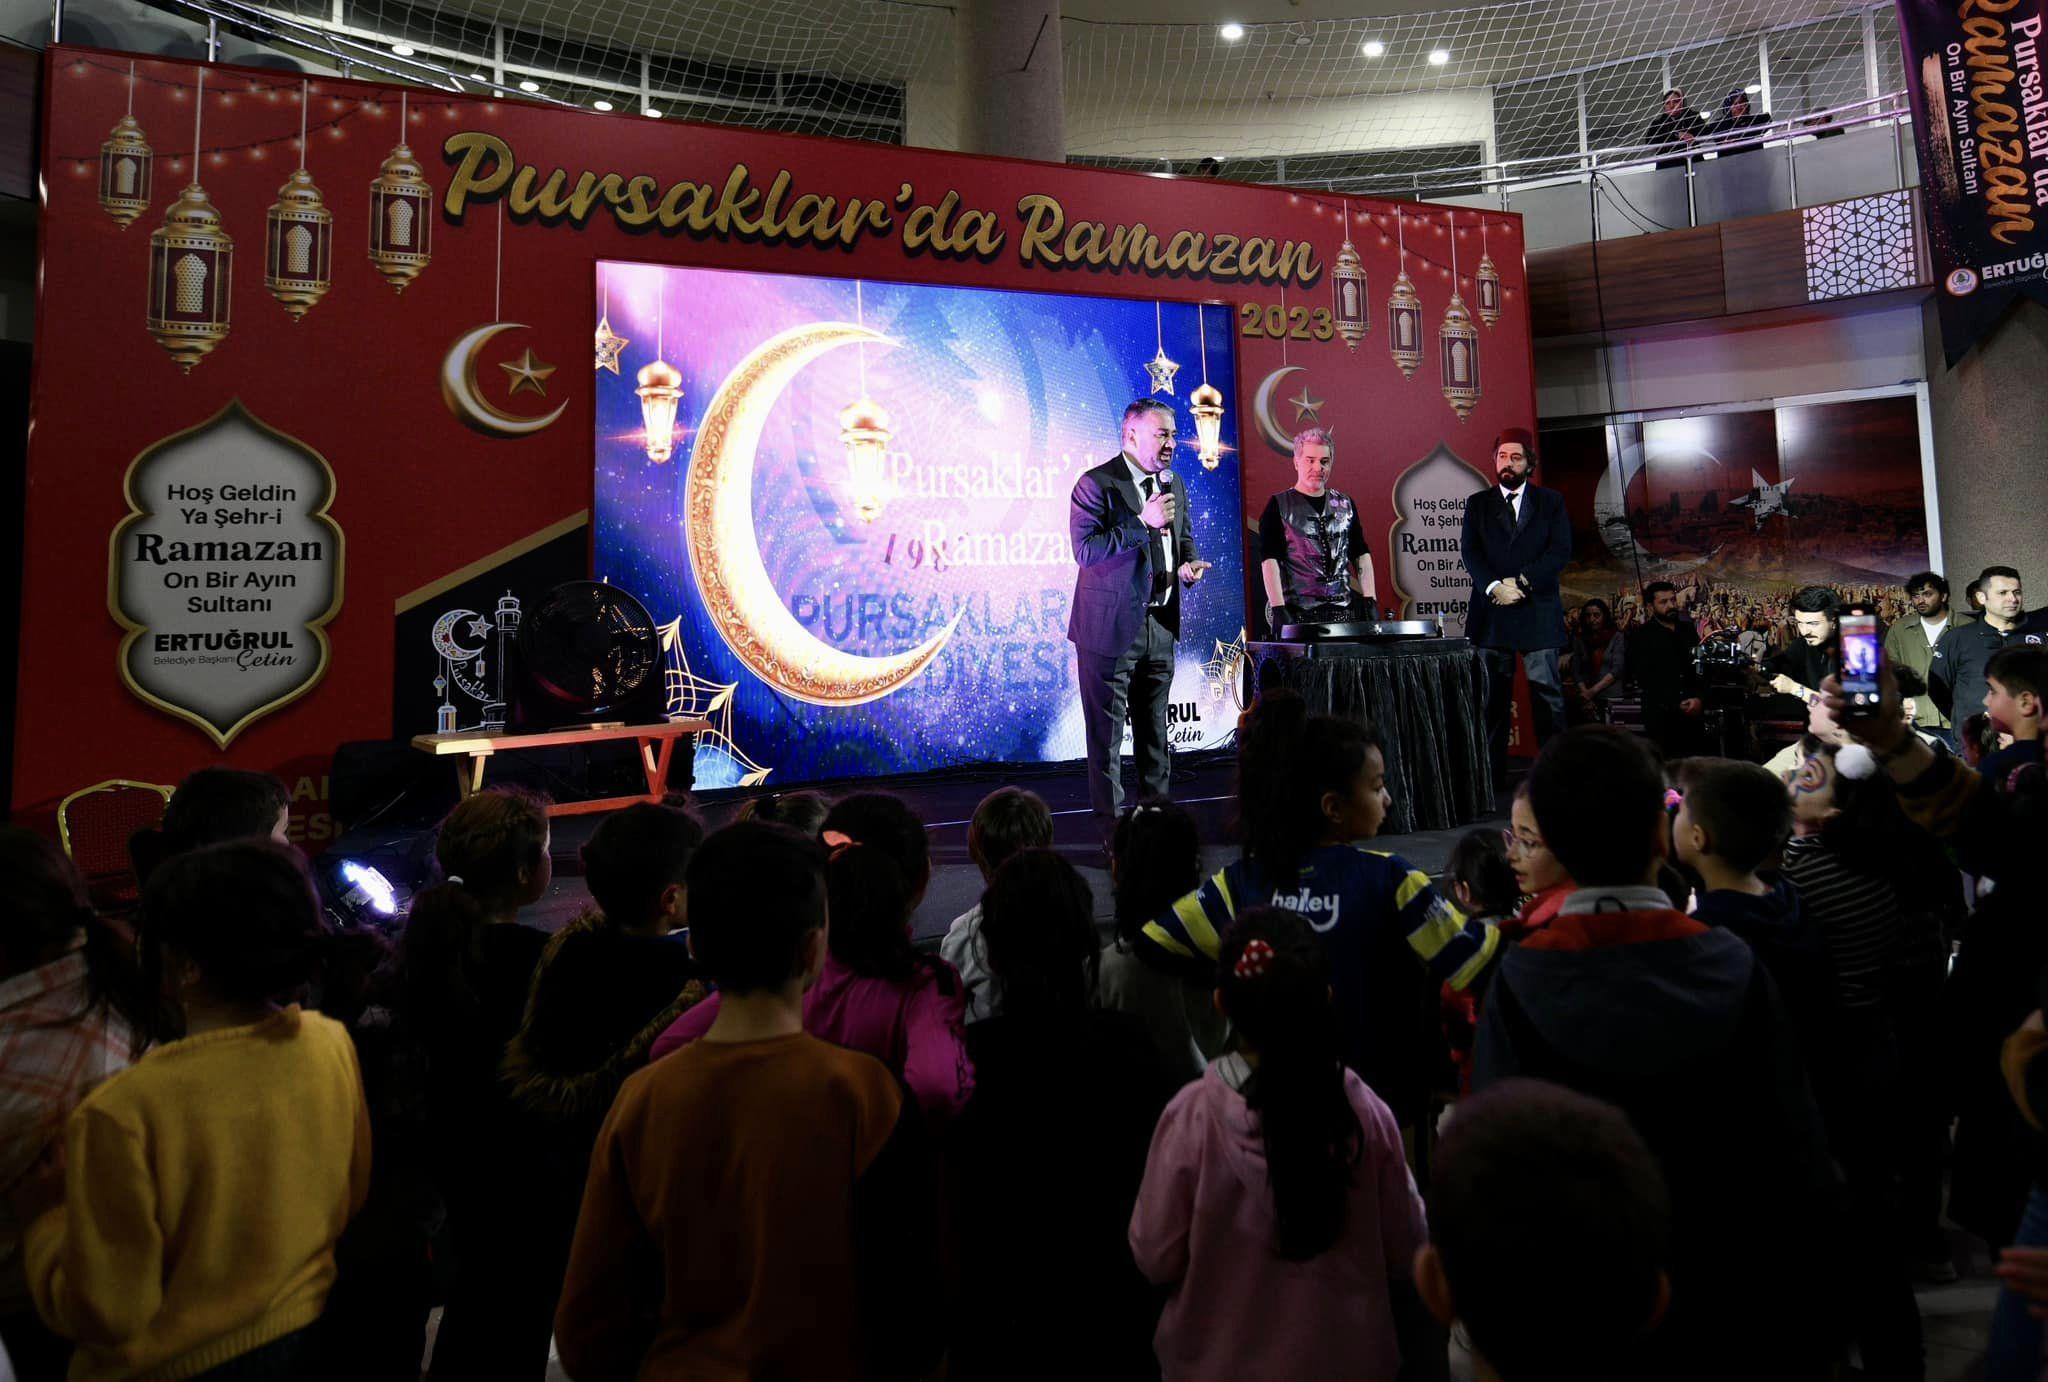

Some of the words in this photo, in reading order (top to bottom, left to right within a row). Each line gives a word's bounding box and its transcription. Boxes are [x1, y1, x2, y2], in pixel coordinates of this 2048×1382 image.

[1946, 42, 1961, 66] On
[1950, 70, 1967, 93] Bir
[1953, 99, 1969, 134] Ayın
[1960, 138, 1979, 195] Sultanı
[442, 130, 1005, 255] Pursaklar'da
[1018, 194, 1322, 283] Ramazan
[1982, 252, 2048, 281] ERTUĞ
[1240, 302, 1334, 340] 2023
[167, 484, 214, 505] Hoş
[219, 484, 296, 502] Geldin
[1413, 498, 1437, 513] Hoş
[1439, 498, 1466, 510] Geld
[180, 508, 208, 525] Ya
[214, 508, 282, 529] Şehr-i
[1421, 515, 1435, 527] Ya
[1438, 514, 1464, 529] Şehr
[133, 533, 323, 566] Ramazan
[1401, 533, 1459, 555] Rama
[1417, 559, 1435, 571] On
[1437, 559, 1454, 571] Bir
[163, 572, 198, 589] On
[205, 571, 239, 588] Bir
[243, 571, 296, 592] Ayın
[187, 596, 272, 613] Sultanı
[1416, 599, 1468, 615] ERTUĞR
[154, 629, 294, 652] ERTUĞRUL
[236, 649, 297, 672] Çetin
